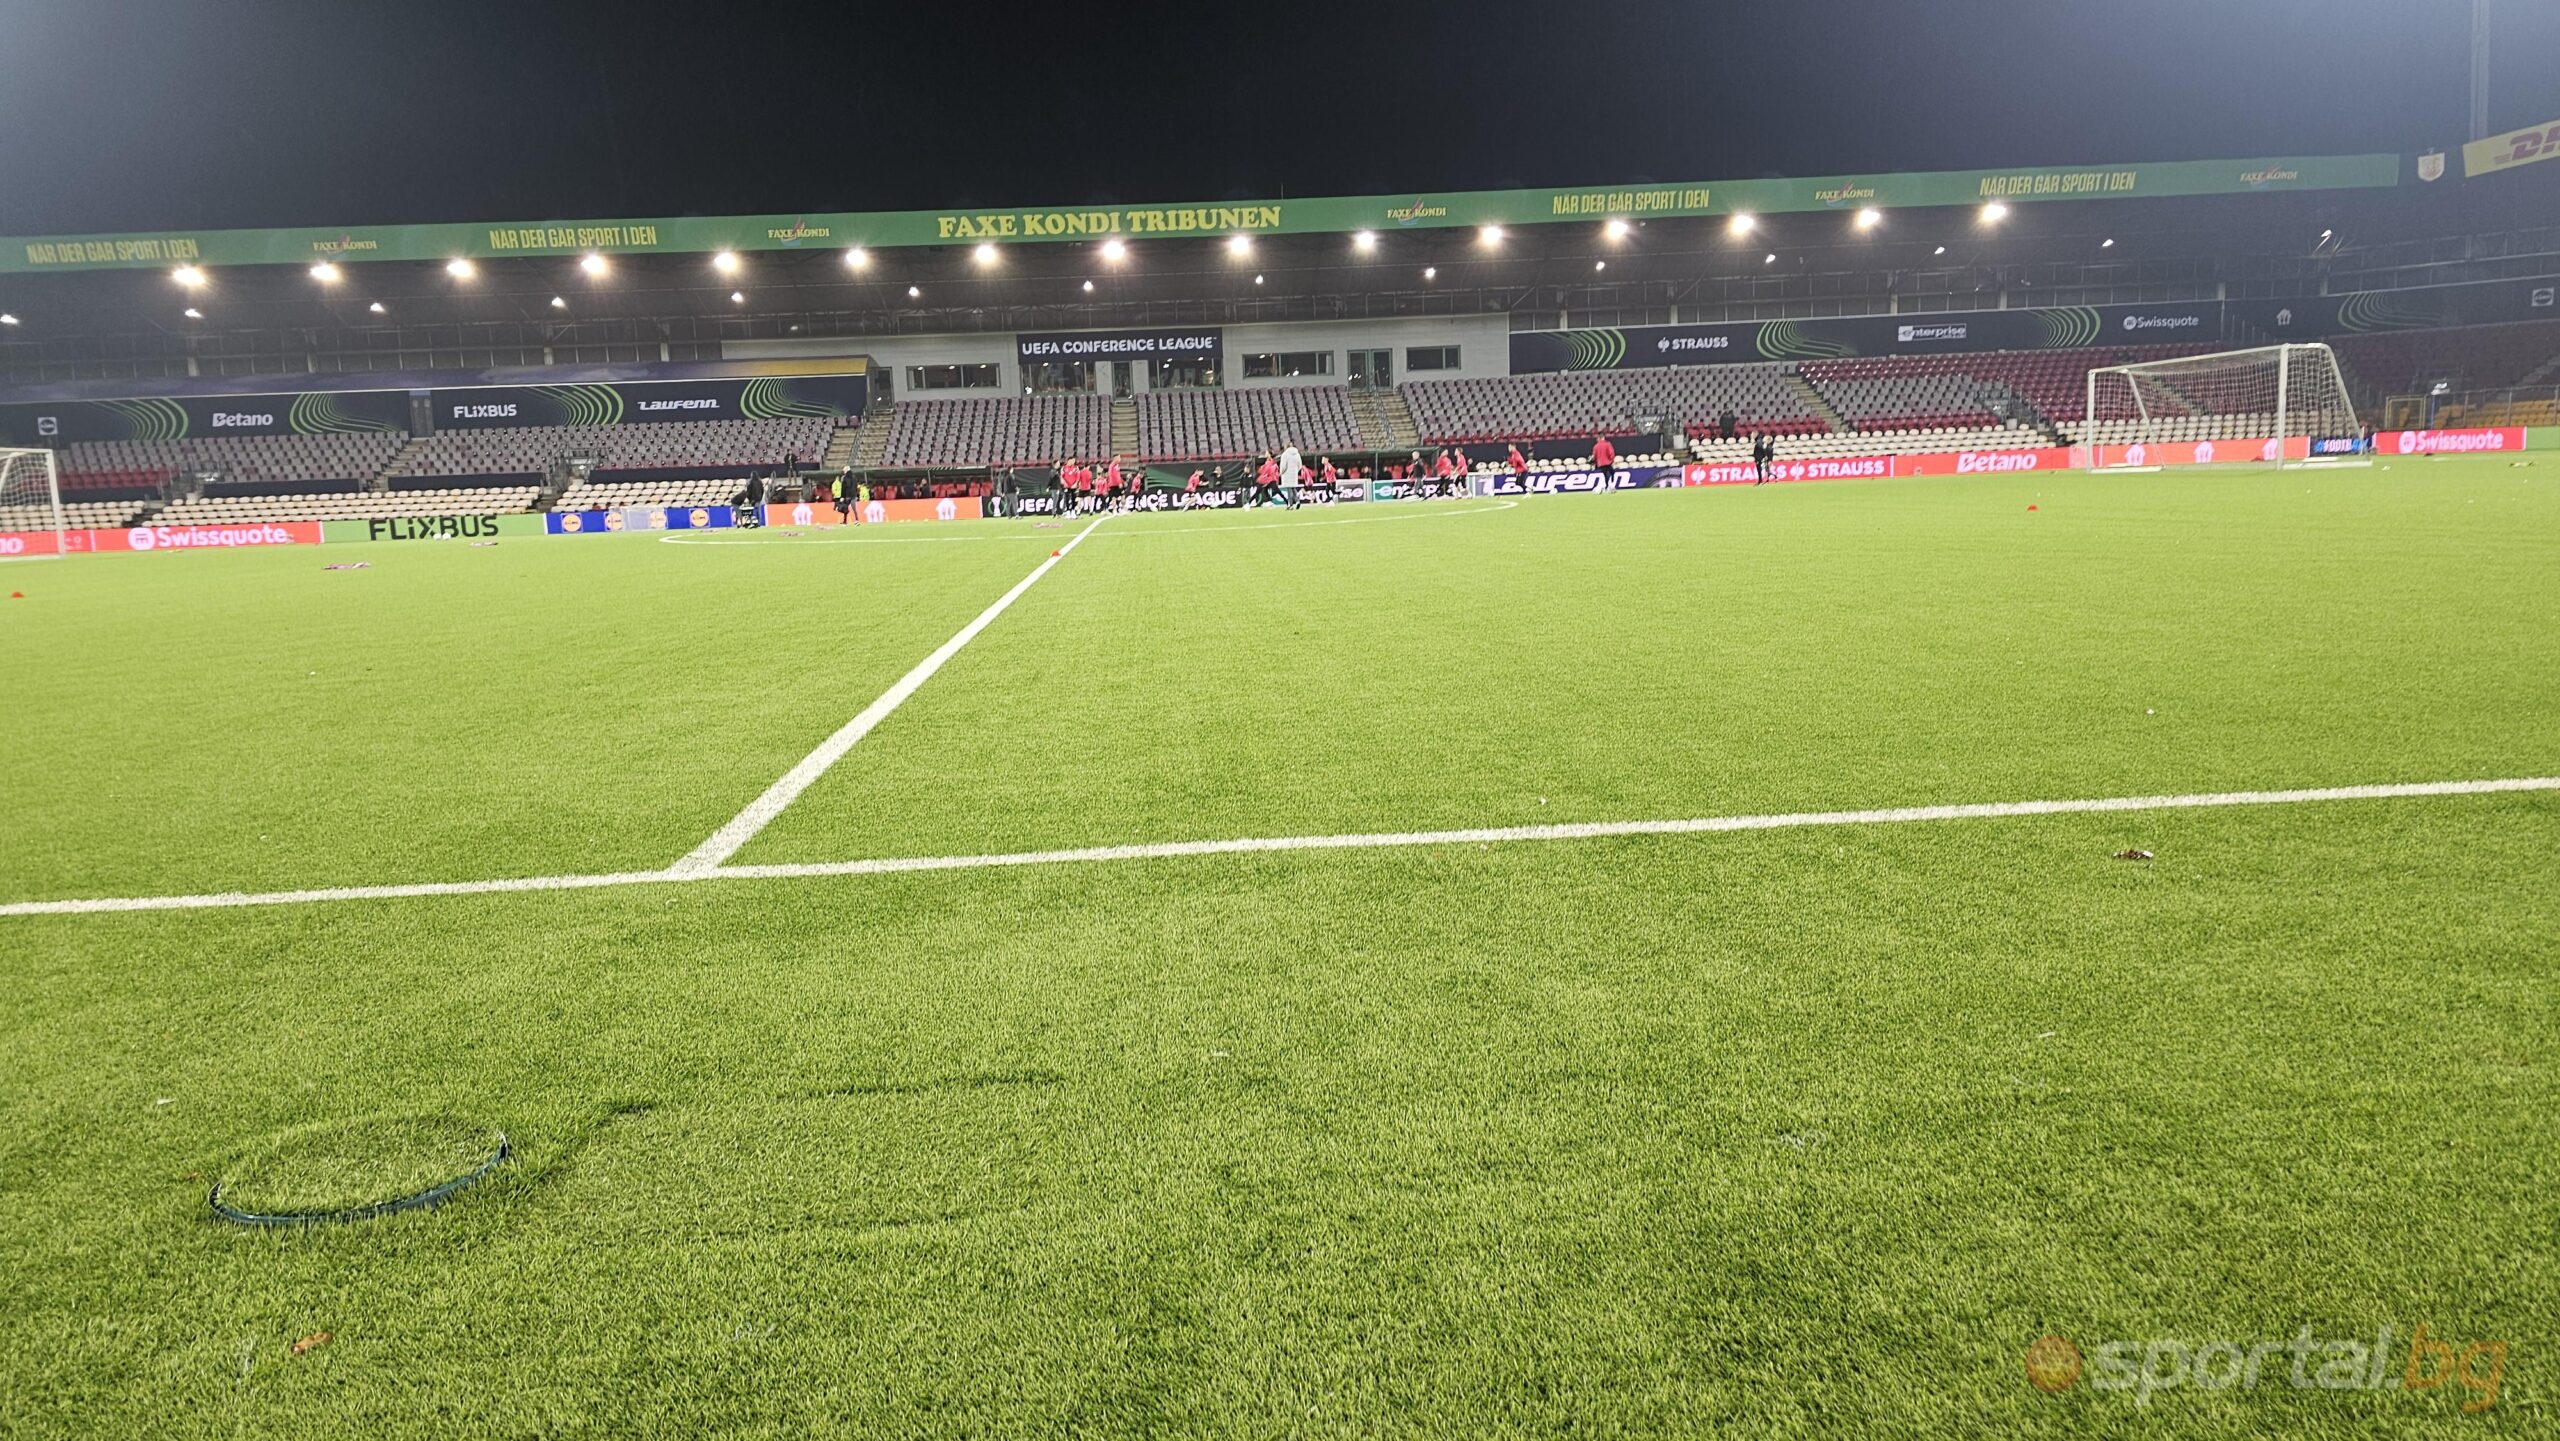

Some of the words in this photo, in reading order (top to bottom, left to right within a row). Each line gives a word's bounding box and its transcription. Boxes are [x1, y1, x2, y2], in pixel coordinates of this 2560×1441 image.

[2007, 175, 2033, 195] DER
[2061, 173, 2103, 192] SPORT
[2103, 172, 2110, 191] I
[2111, 171, 2137, 190] DEN
[1581, 193, 1606, 214] DER
[1635, 190, 1677, 211] SPORT
[1678, 190, 1683, 209] I
[1685, 189, 1710, 208] DEN
[937, 214, 1018, 239] FAXE
[1022, 212, 1121, 236] KONDI
[1126, 206, 1282, 233] TRIBUNEN
[520, 229, 547, 249] DER
[578, 227, 621, 247] SPORT
[623, 227, 628, 245] I
[629, 226, 657, 246] DEN
[57, 242, 86, 263] DER
[116, 239, 162, 261] SPORT
[161, 239, 170, 259] I
[169, 238, 199, 259] DEN
[2137, 315, 2199, 329] Swissquote
[1022, 341, 1060, 355] UEFA
[1062, 338, 1155, 354] CONFERENCE
[1672, 336, 1729, 350] STRAUSS
[212, 412, 274, 427] Betano
[2416, 429, 2504, 452] Swissquote
[1807, 460, 1885, 478] STRAUSS
[1956, 452, 2037, 473] Betano
[156, 524, 288, 548] Swissquote
